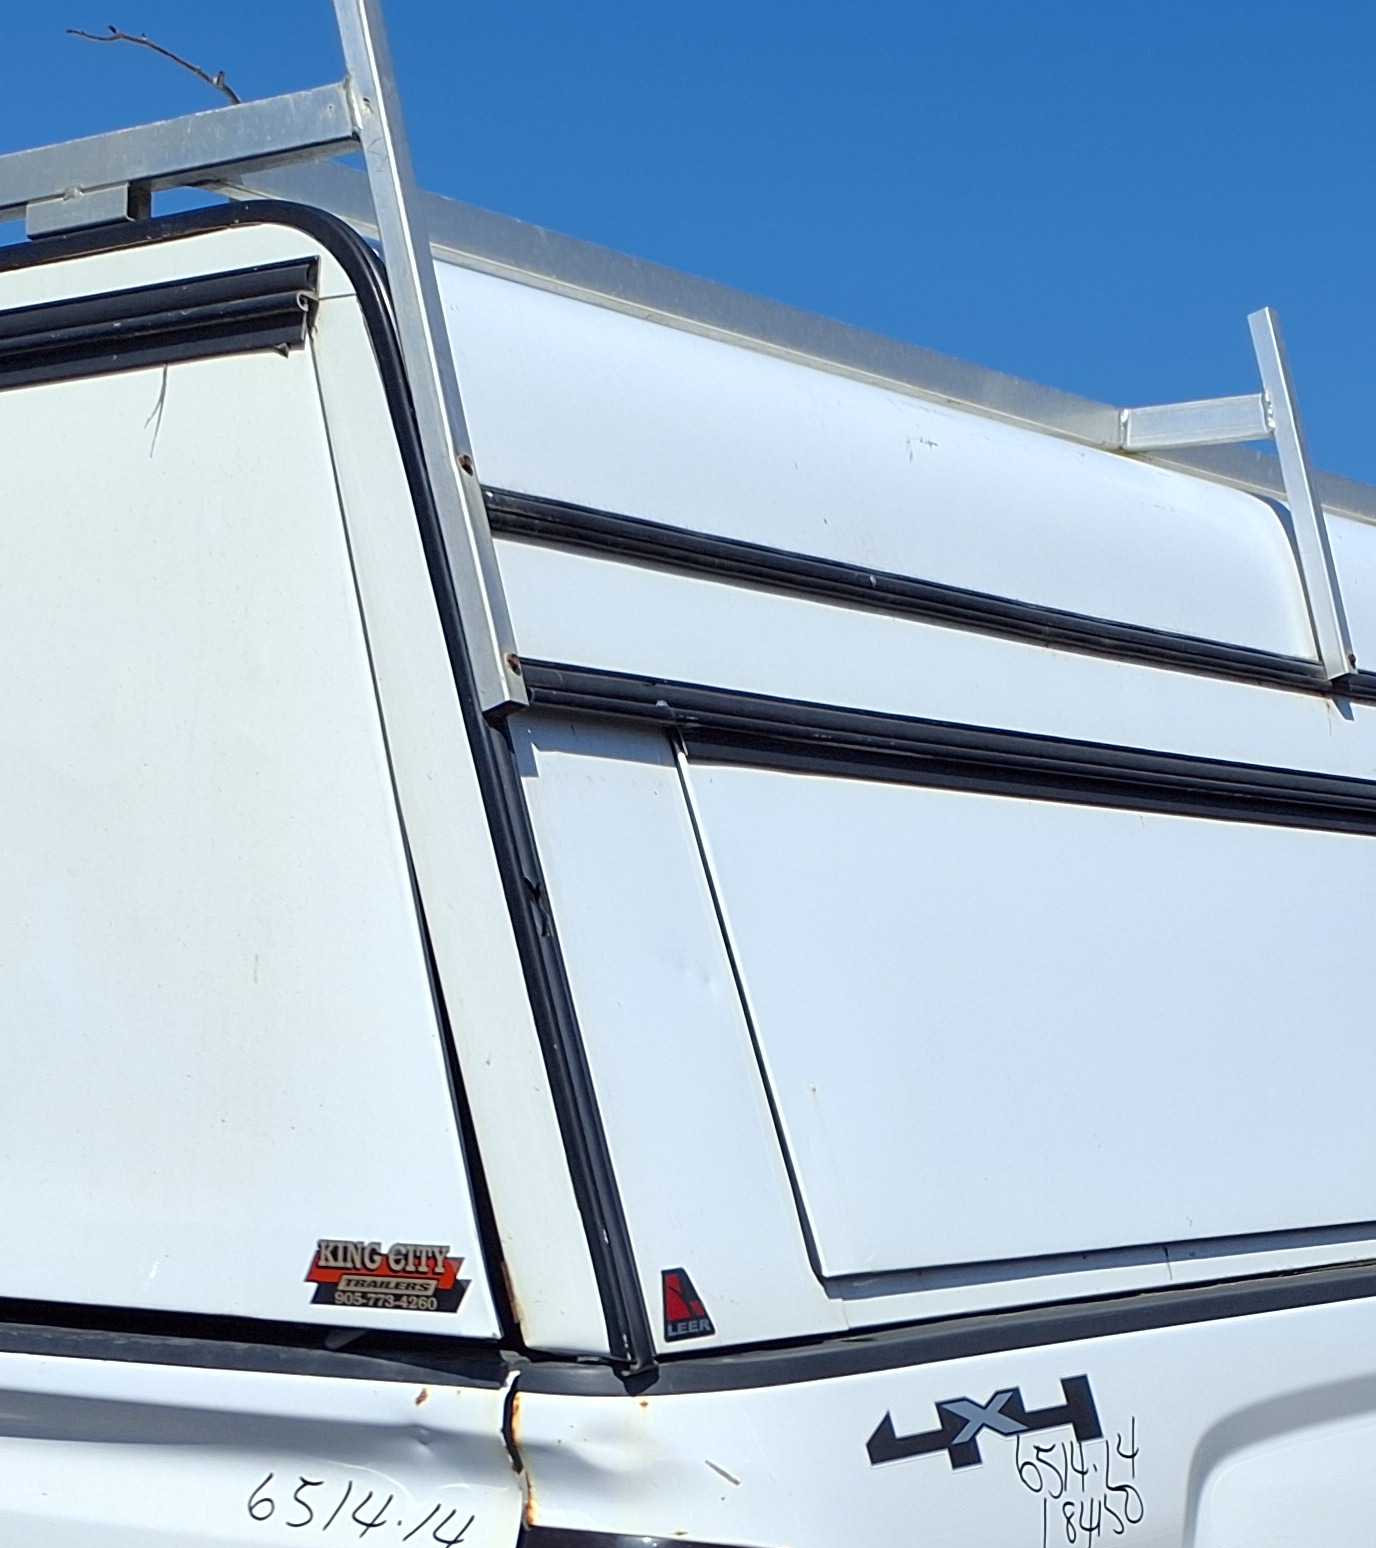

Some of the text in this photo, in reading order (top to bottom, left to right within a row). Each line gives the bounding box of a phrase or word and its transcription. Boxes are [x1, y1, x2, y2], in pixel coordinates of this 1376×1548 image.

[318, 1239, 450, 1275] KING CITY
[343, 1276, 432, 1293] TRAILERS
[334, 1291, 438, 1311] 905-773-4260
[667, 1318, 711, 1337] LEER
